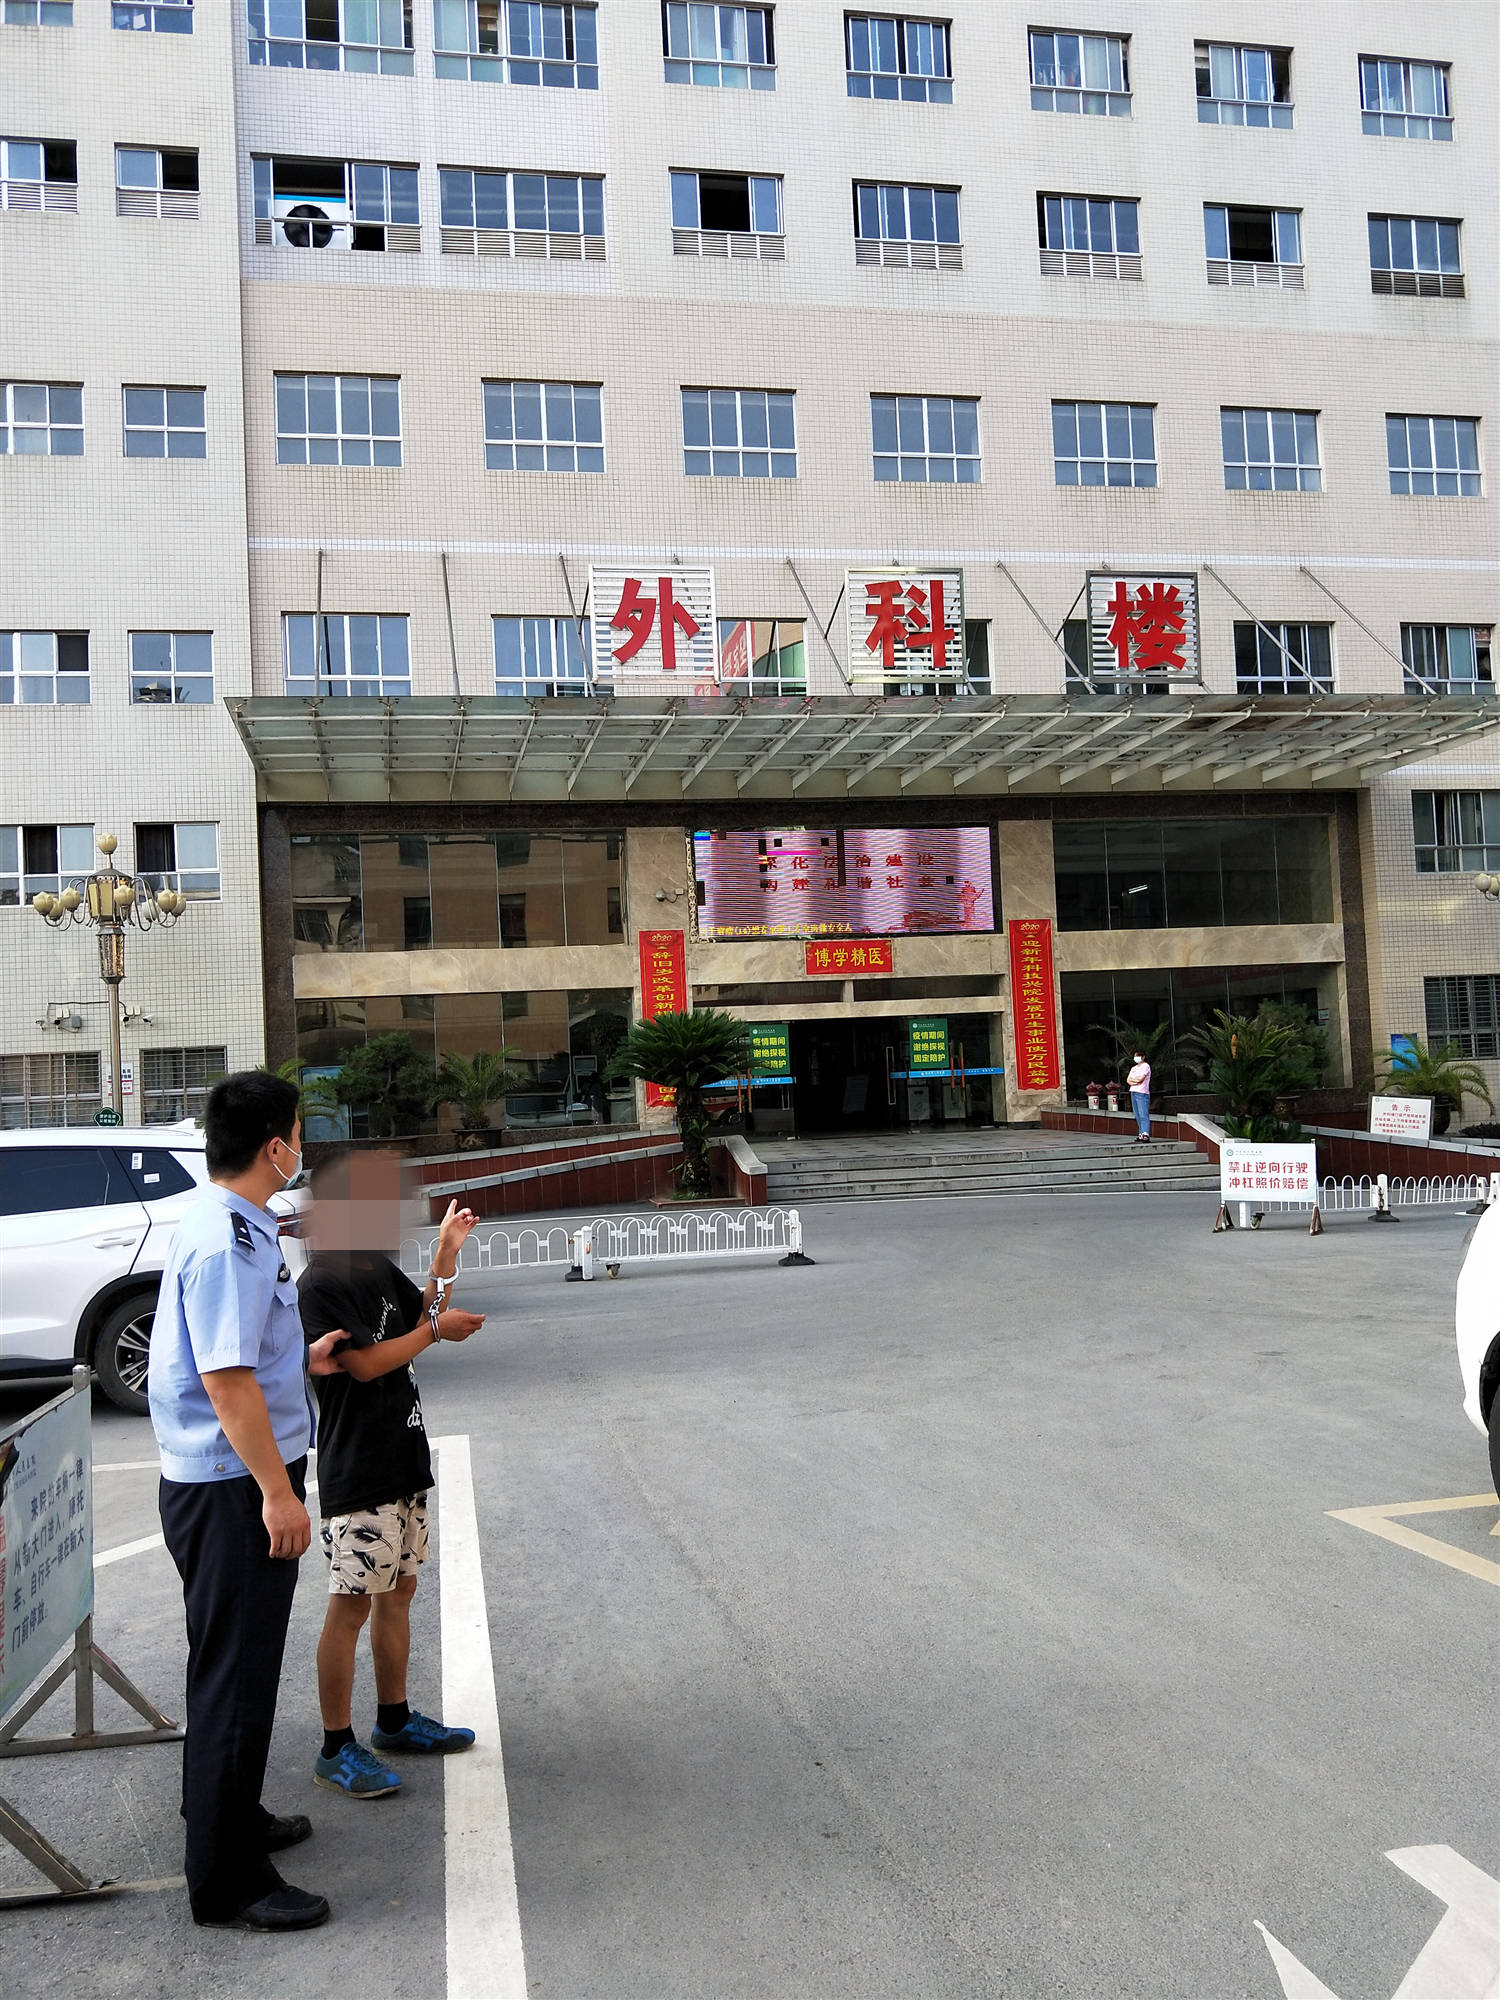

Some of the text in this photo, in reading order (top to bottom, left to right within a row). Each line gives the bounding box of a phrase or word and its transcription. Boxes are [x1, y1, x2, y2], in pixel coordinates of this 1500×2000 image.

[1020, 923, 1040, 931] 2020
[651, 934, 672, 942] 2020
[814, 947, 884, 967] 博学精医
[912, 1031, 945, 1040] 疫情期间
[752, 1036, 786, 1046] 疫情期间
[913, 1042, 945, 1052] 谢绝探视
[753, 1048, 787, 1058] 谢绝探视
[913, 1054, 946, 1063] 固定陪护
[1228, 1161, 1309, 1174] 禁止逆向行驶
[1229, 1177, 1309, 1190] 冲杠照价赔偿
